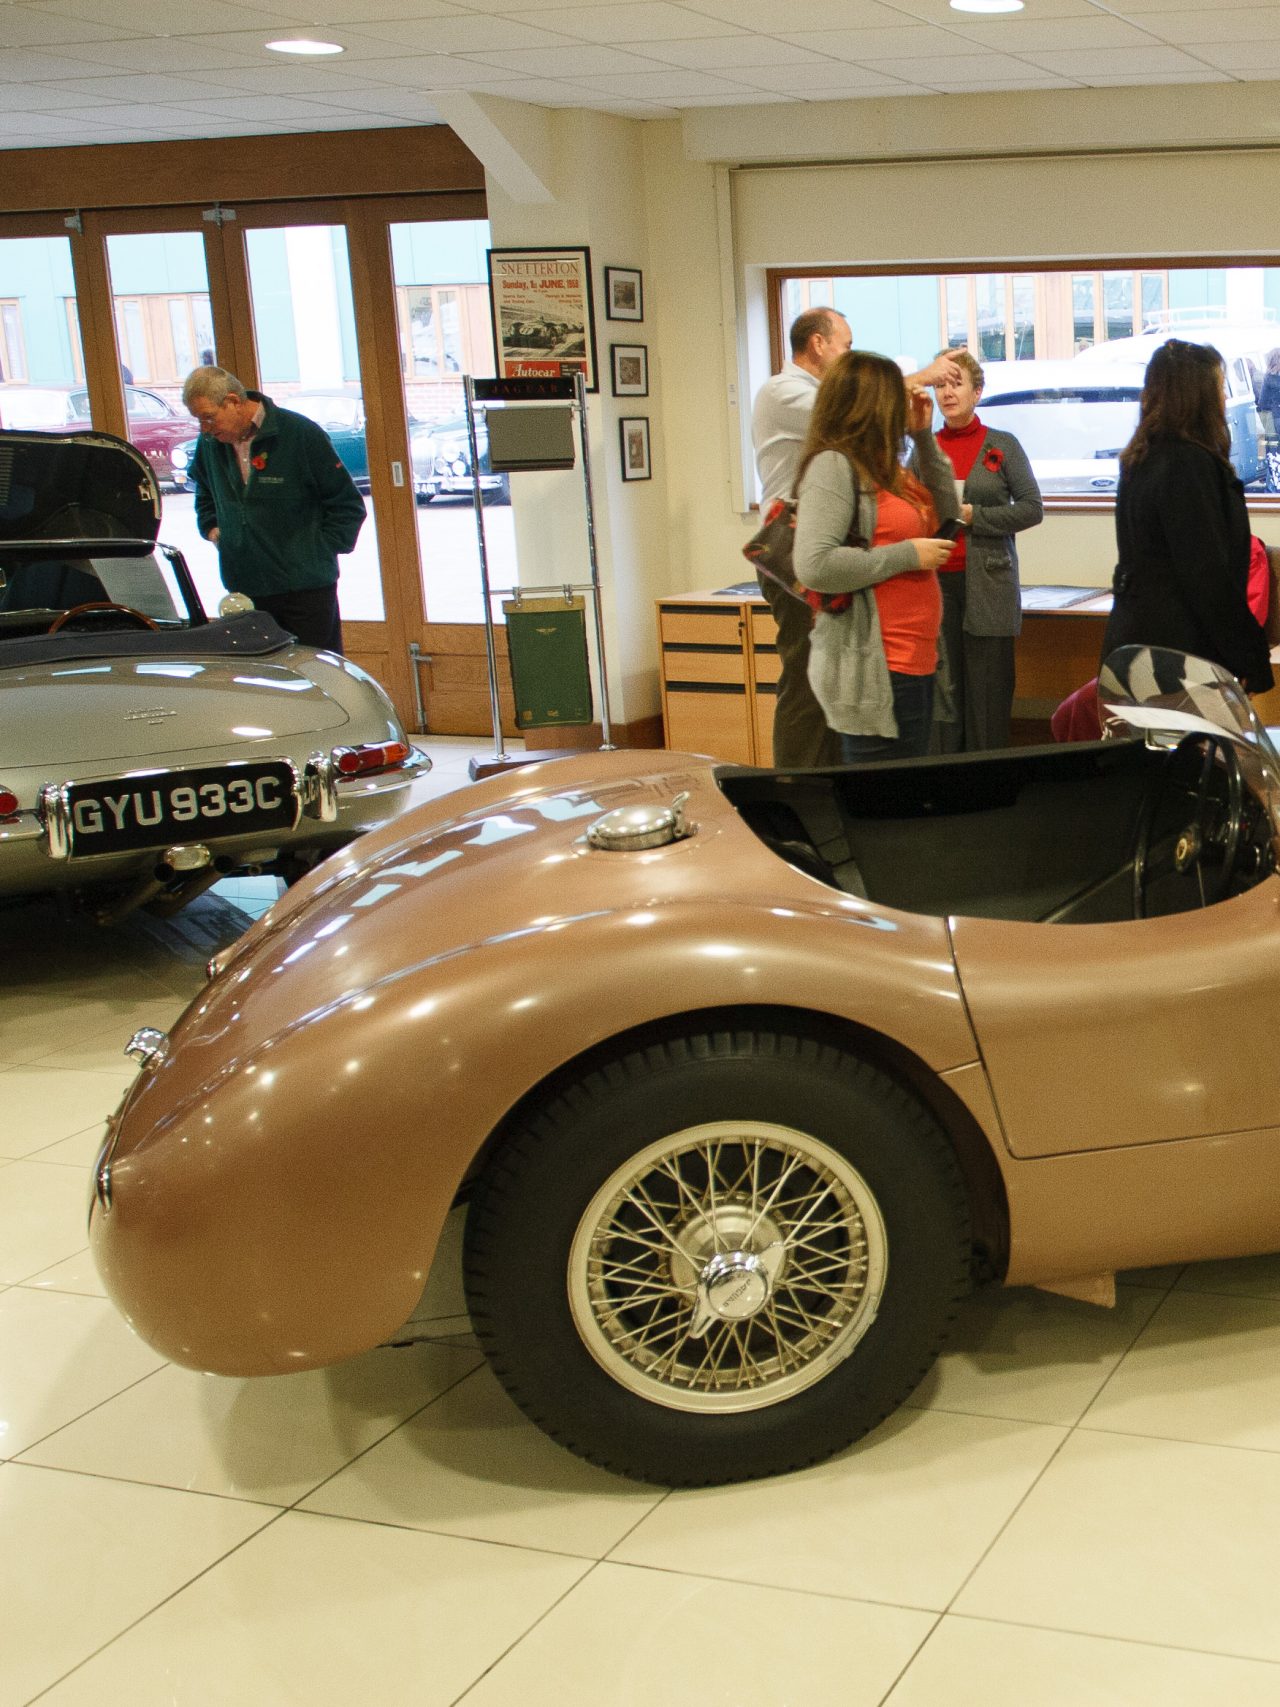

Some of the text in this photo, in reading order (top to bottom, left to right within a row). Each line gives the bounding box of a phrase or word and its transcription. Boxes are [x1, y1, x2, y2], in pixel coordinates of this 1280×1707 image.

[501, 262, 579, 275] SNETTERTON
[512, 363, 555, 377] Autocar
[491, 384, 557, 393] JAGUAR
[74, 776, 283, 834] GYU 933C
